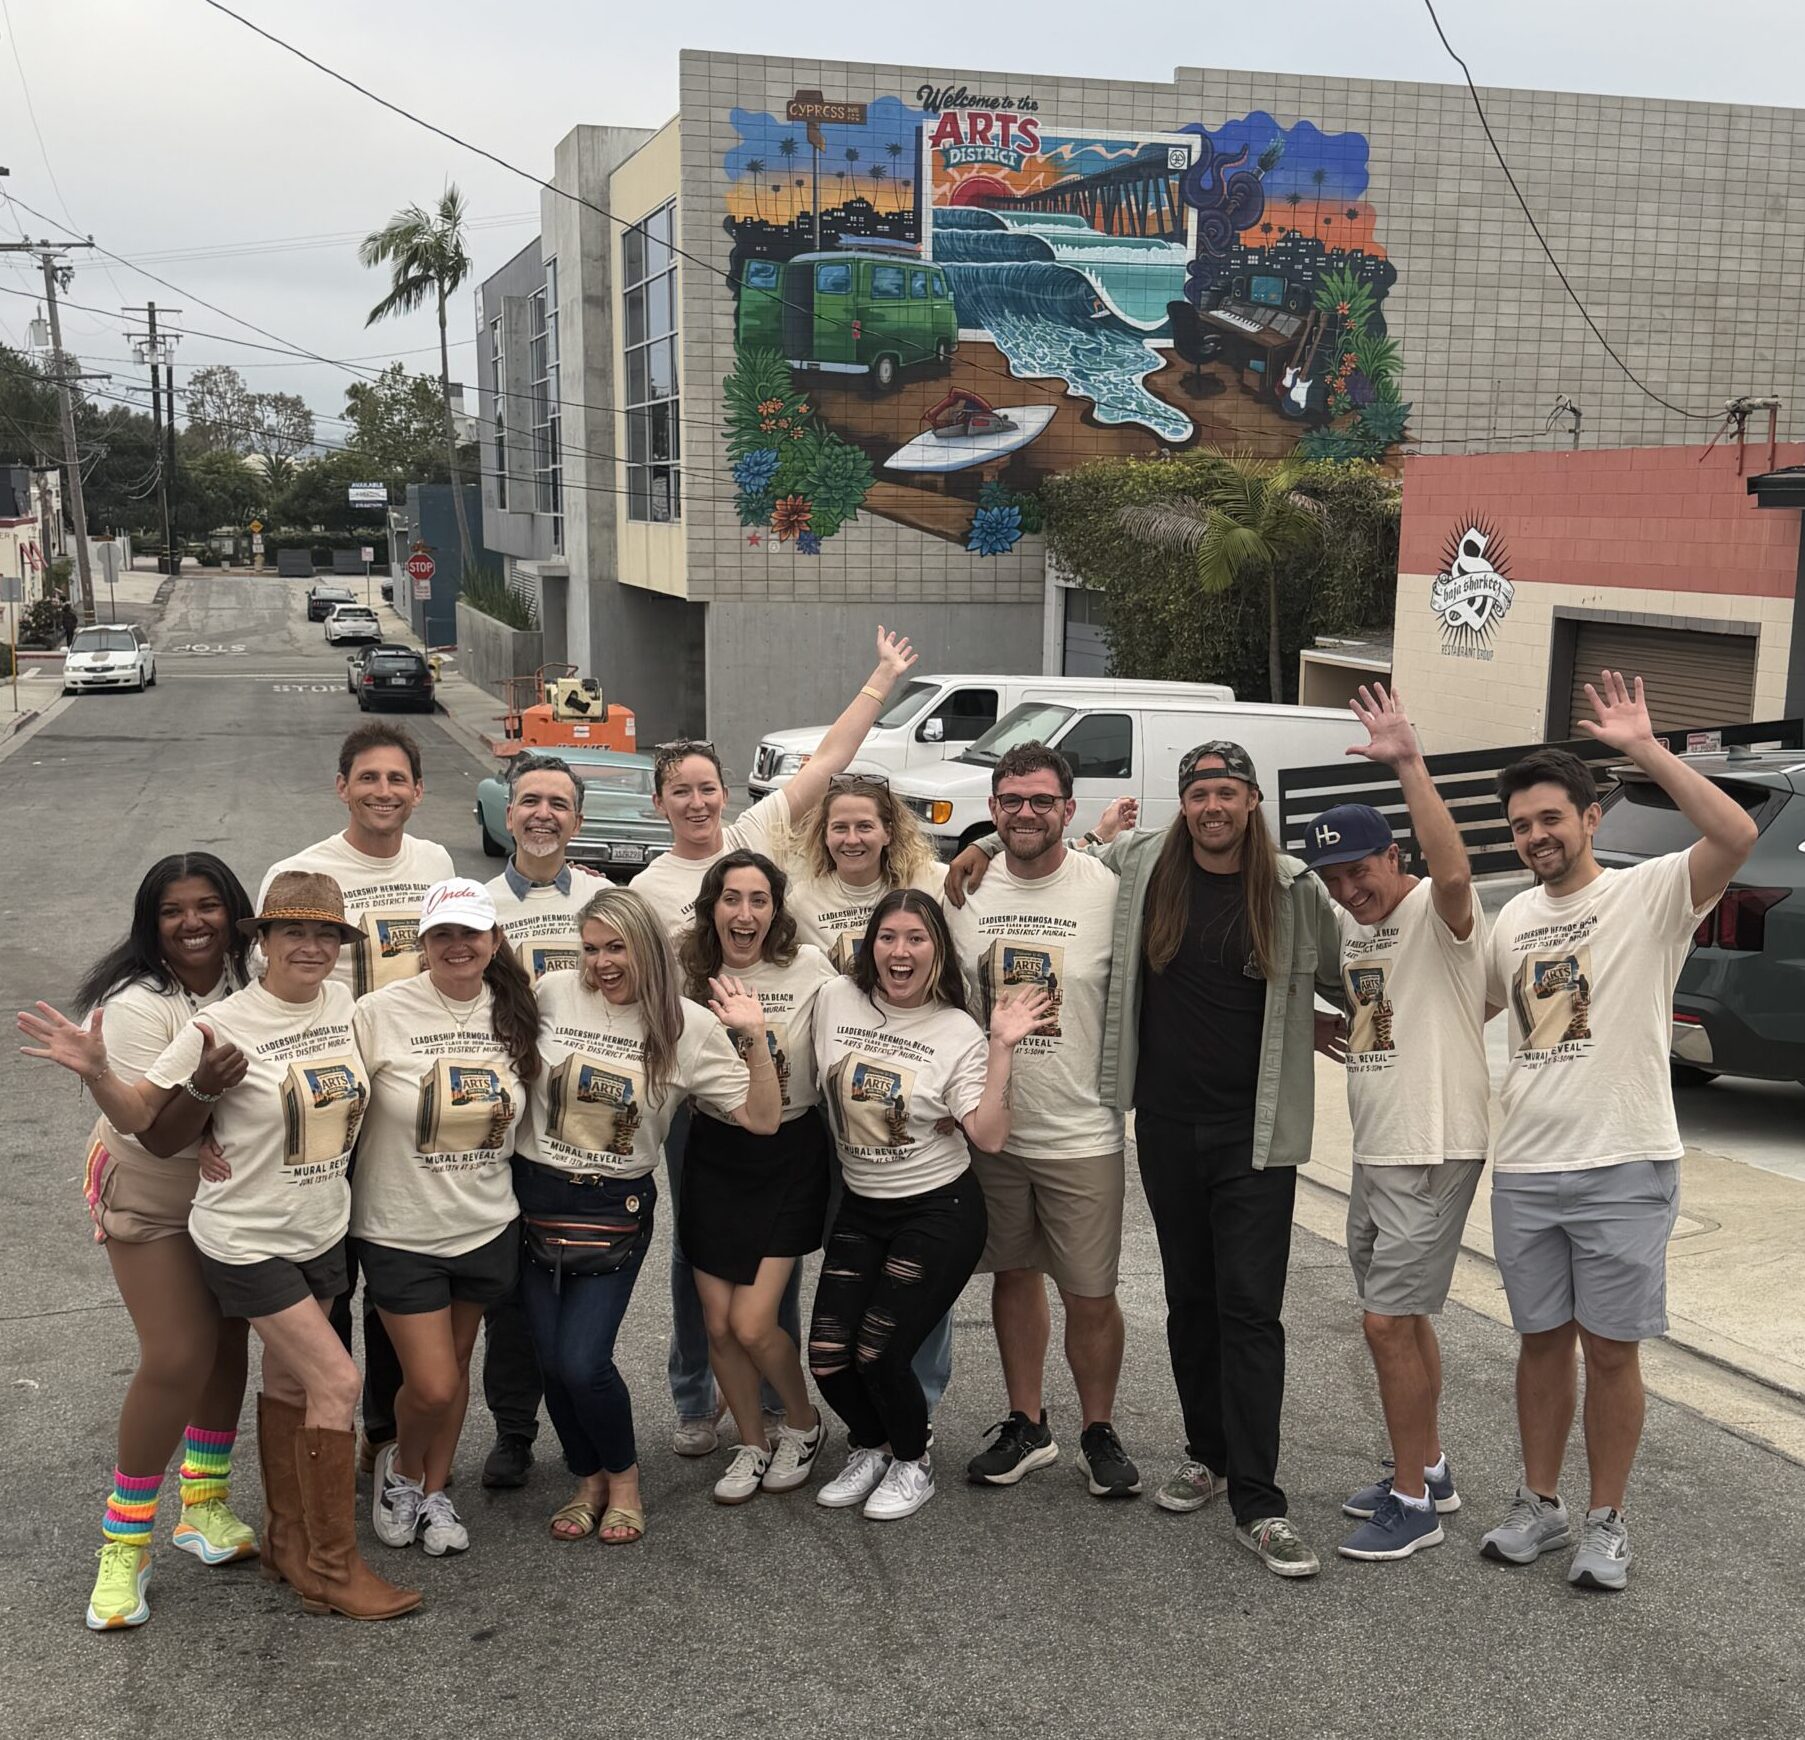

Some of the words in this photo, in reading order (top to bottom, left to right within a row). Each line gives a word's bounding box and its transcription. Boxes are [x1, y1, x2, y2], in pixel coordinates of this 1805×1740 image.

[917, 84, 1000, 114] Welcome
[1002, 96, 1015, 109] to
[1017, 95, 1039, 111] the
[789, 103, 845, 119] CYPRESS
[928, 111, 1040, 155] ARTS
[949, 147, 1018, 165] DISTRICT
[409, 561, 433, 573] STOP
[1443, 581, 1461, 602] baja
[380, 883, 412, 892] HERMOSA
[350, 901, 370, 909] ARTS
[372, 897, 405, 907] DISTRICT
[818, 908, 858, 922] LEADERSHIP
[978, 915, 1018, 926] LEADERSHIP
[1019, 915, 1052, 924] HERMOSA
[1053, 917, 1077, 928] BEACH
[830, 922, 848, 930] ARTS
[1007, 928, 1040, 936] DISTRICT
[1042, 929, 1067, 937] MURAL
[508, 931, 529, 940] ARTS
[532, 927, 566, 937] DISTRICT
[1514, 927, 1549, 943] LEADERSHIP
[547, 960, 576, 972] ARTS
[1014, 960, 1041, 972] ARTS
[1361, 979, 1380, 991] ARTS
[771, 993, 794, 1001] BEACH
[256, 1033, 302, 1055] LEADERSHIP
[410, 1032, 456, 1046] LEADERSHIP
[457, 1031, 489, 1041] HERMOSA
[555, 1027, 601, 1040] LEADERSHIP
[602, 1034, 638, 1048] HERMOSA
[836, 1026, 878, 1039] LEADERSHIP
[912, 1040, 935, 1056] BEACH
[274, 1051, 294, 1062] ARTS
[296, 1042, 326, 1057] DISTRICT
[424, 1046, 445, 1055] ARTS
[448, 1046, 481, 1054] DISTRICT
[563, 1039, 585, 1050] ARTS
[587, 1045, 626, 1058] DISTRICT
[843, 1038, 863, 1049] ARTS
[898, 1050, 923, 1062] MURAL
[1359, 1053, 1387, 1063] REVEAL
[322, 1075, 348, 1090] ARTS
[463, 1079, 491, 1089] ARTS
[591, 1081, 623, 1097] ARTS
[864, 1078, 891, 1092] ARTS
[550, 1141, 583, 1158] MURAL
[586, 1152, 623, 1165] REVEAL
[844, 1144, 871, 1156] MURAL
[425, 1153, 458, 1165] MURAL
[462, 1150, 496, 1162] REVEAL
[552, 1153, 569, 1163] JUNE
[293, 1164, 327, 1177] MURAL
[299, 1176, 314, 1186] JUNE
